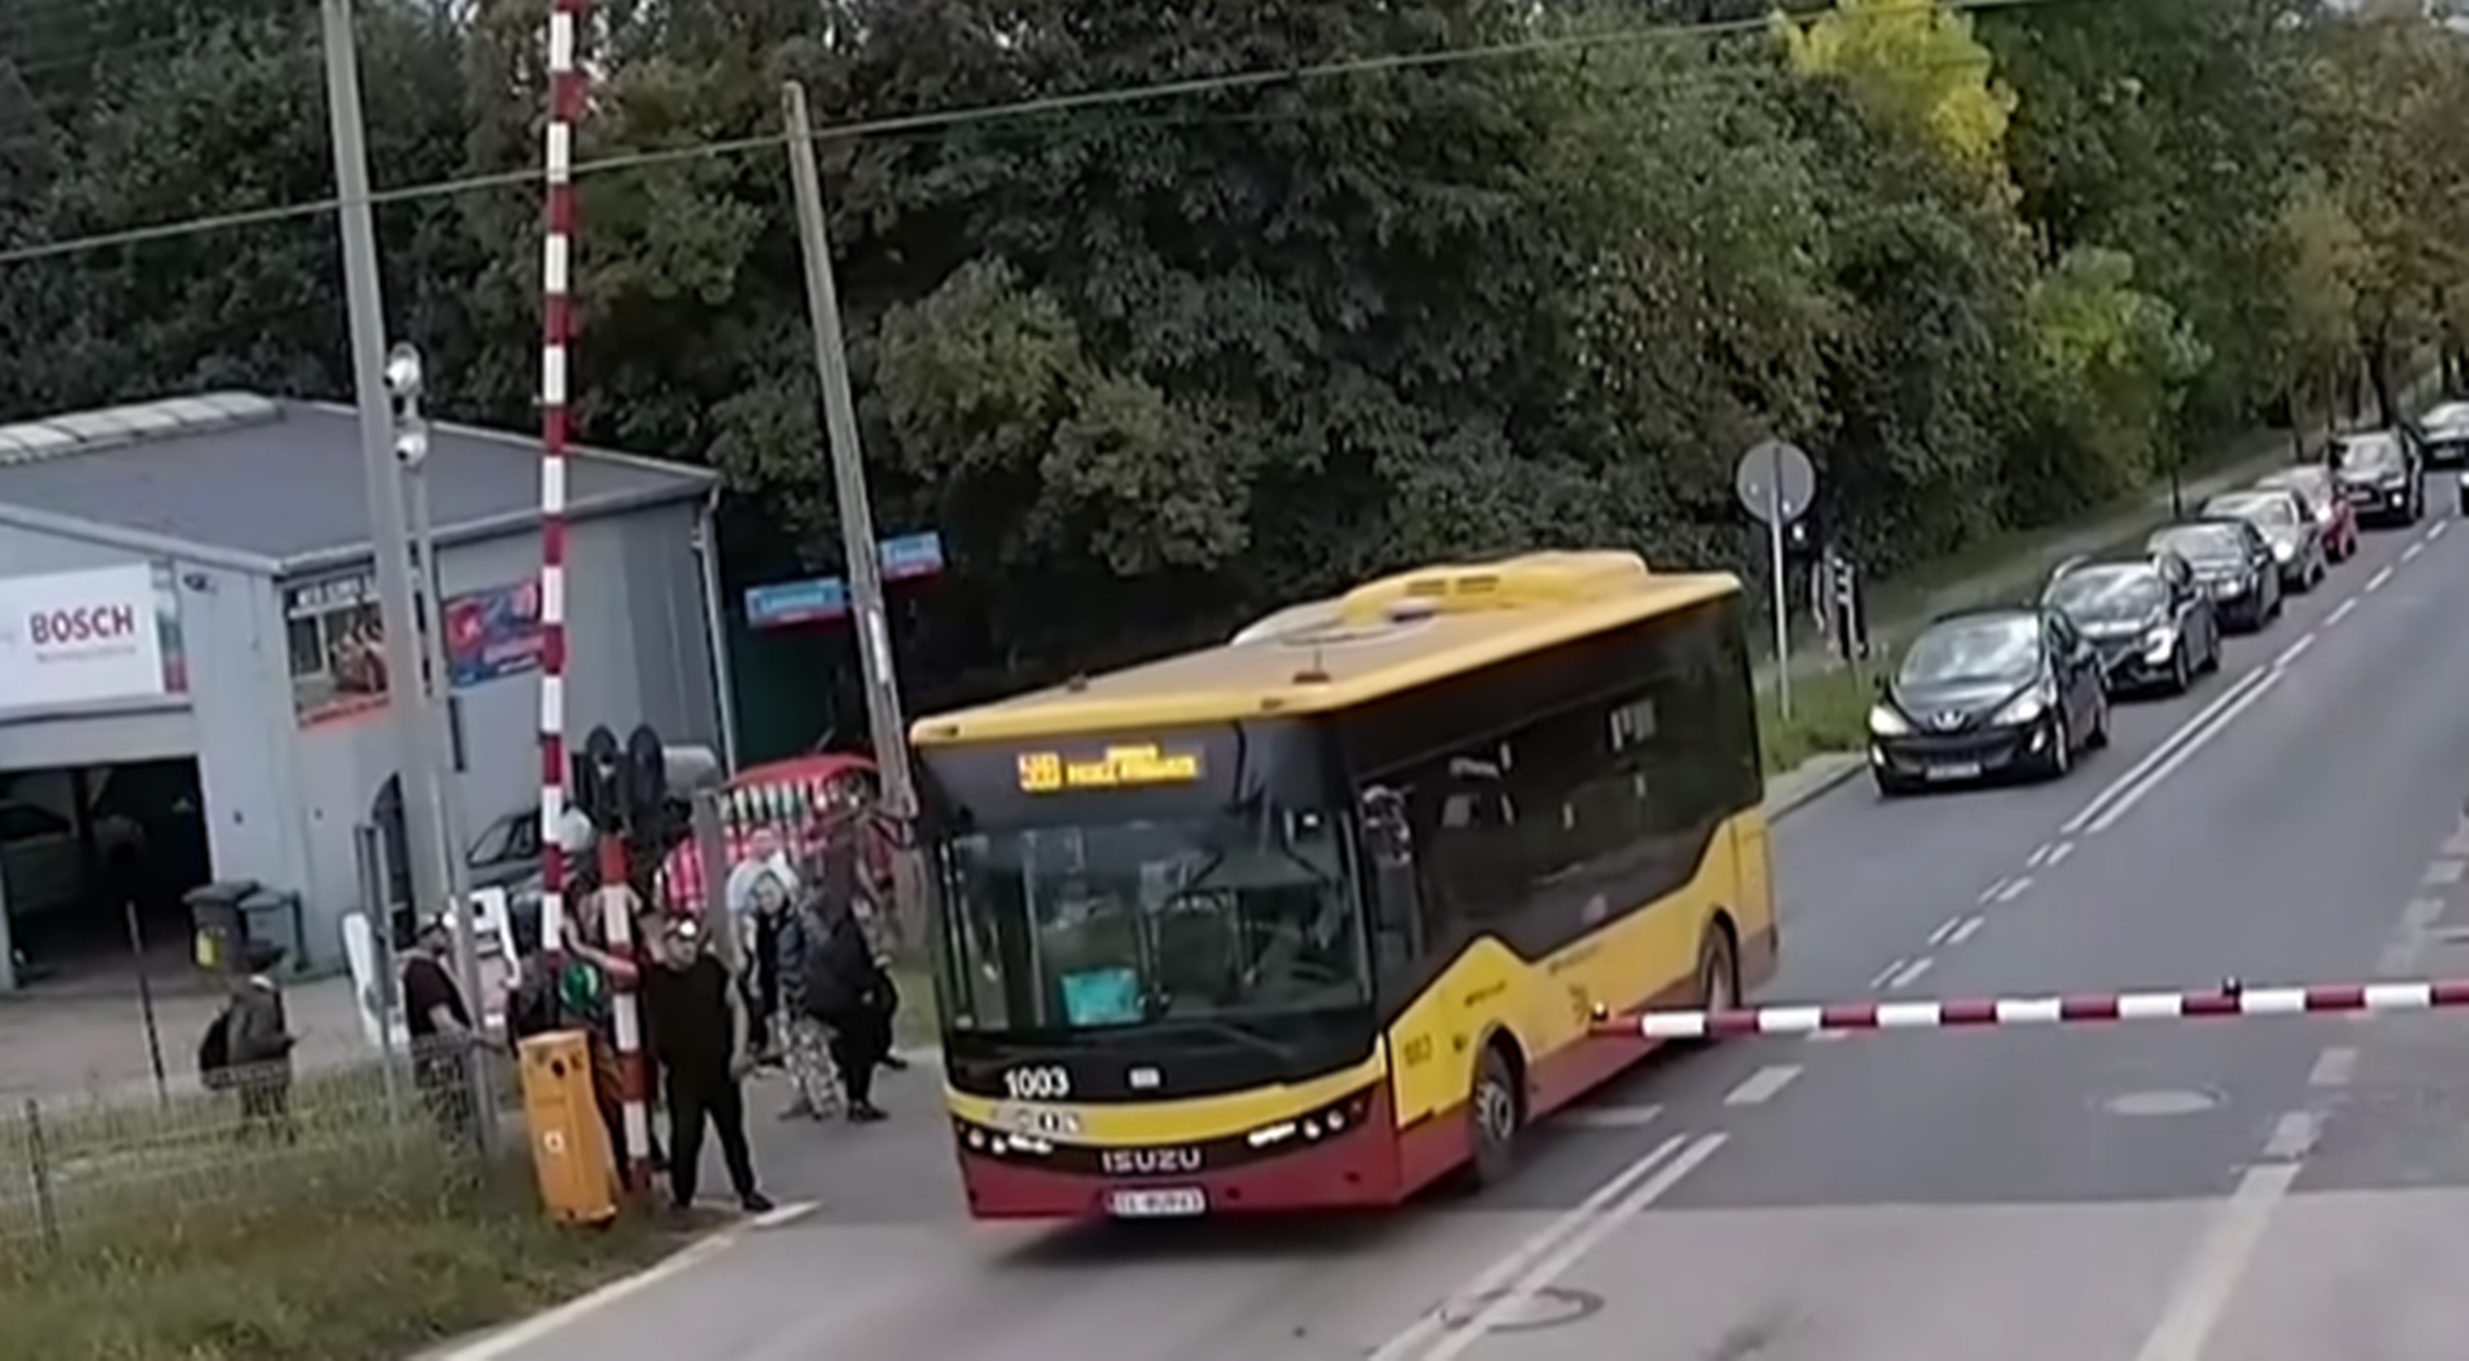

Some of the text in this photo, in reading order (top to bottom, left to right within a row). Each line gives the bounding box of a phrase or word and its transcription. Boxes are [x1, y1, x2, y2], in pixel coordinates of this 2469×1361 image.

[29, 604, 136, 645] BOSCH
[1003, 1064, 1071, 1098] 1003
[1101, 1147, 1202, 1173] ISUZU
